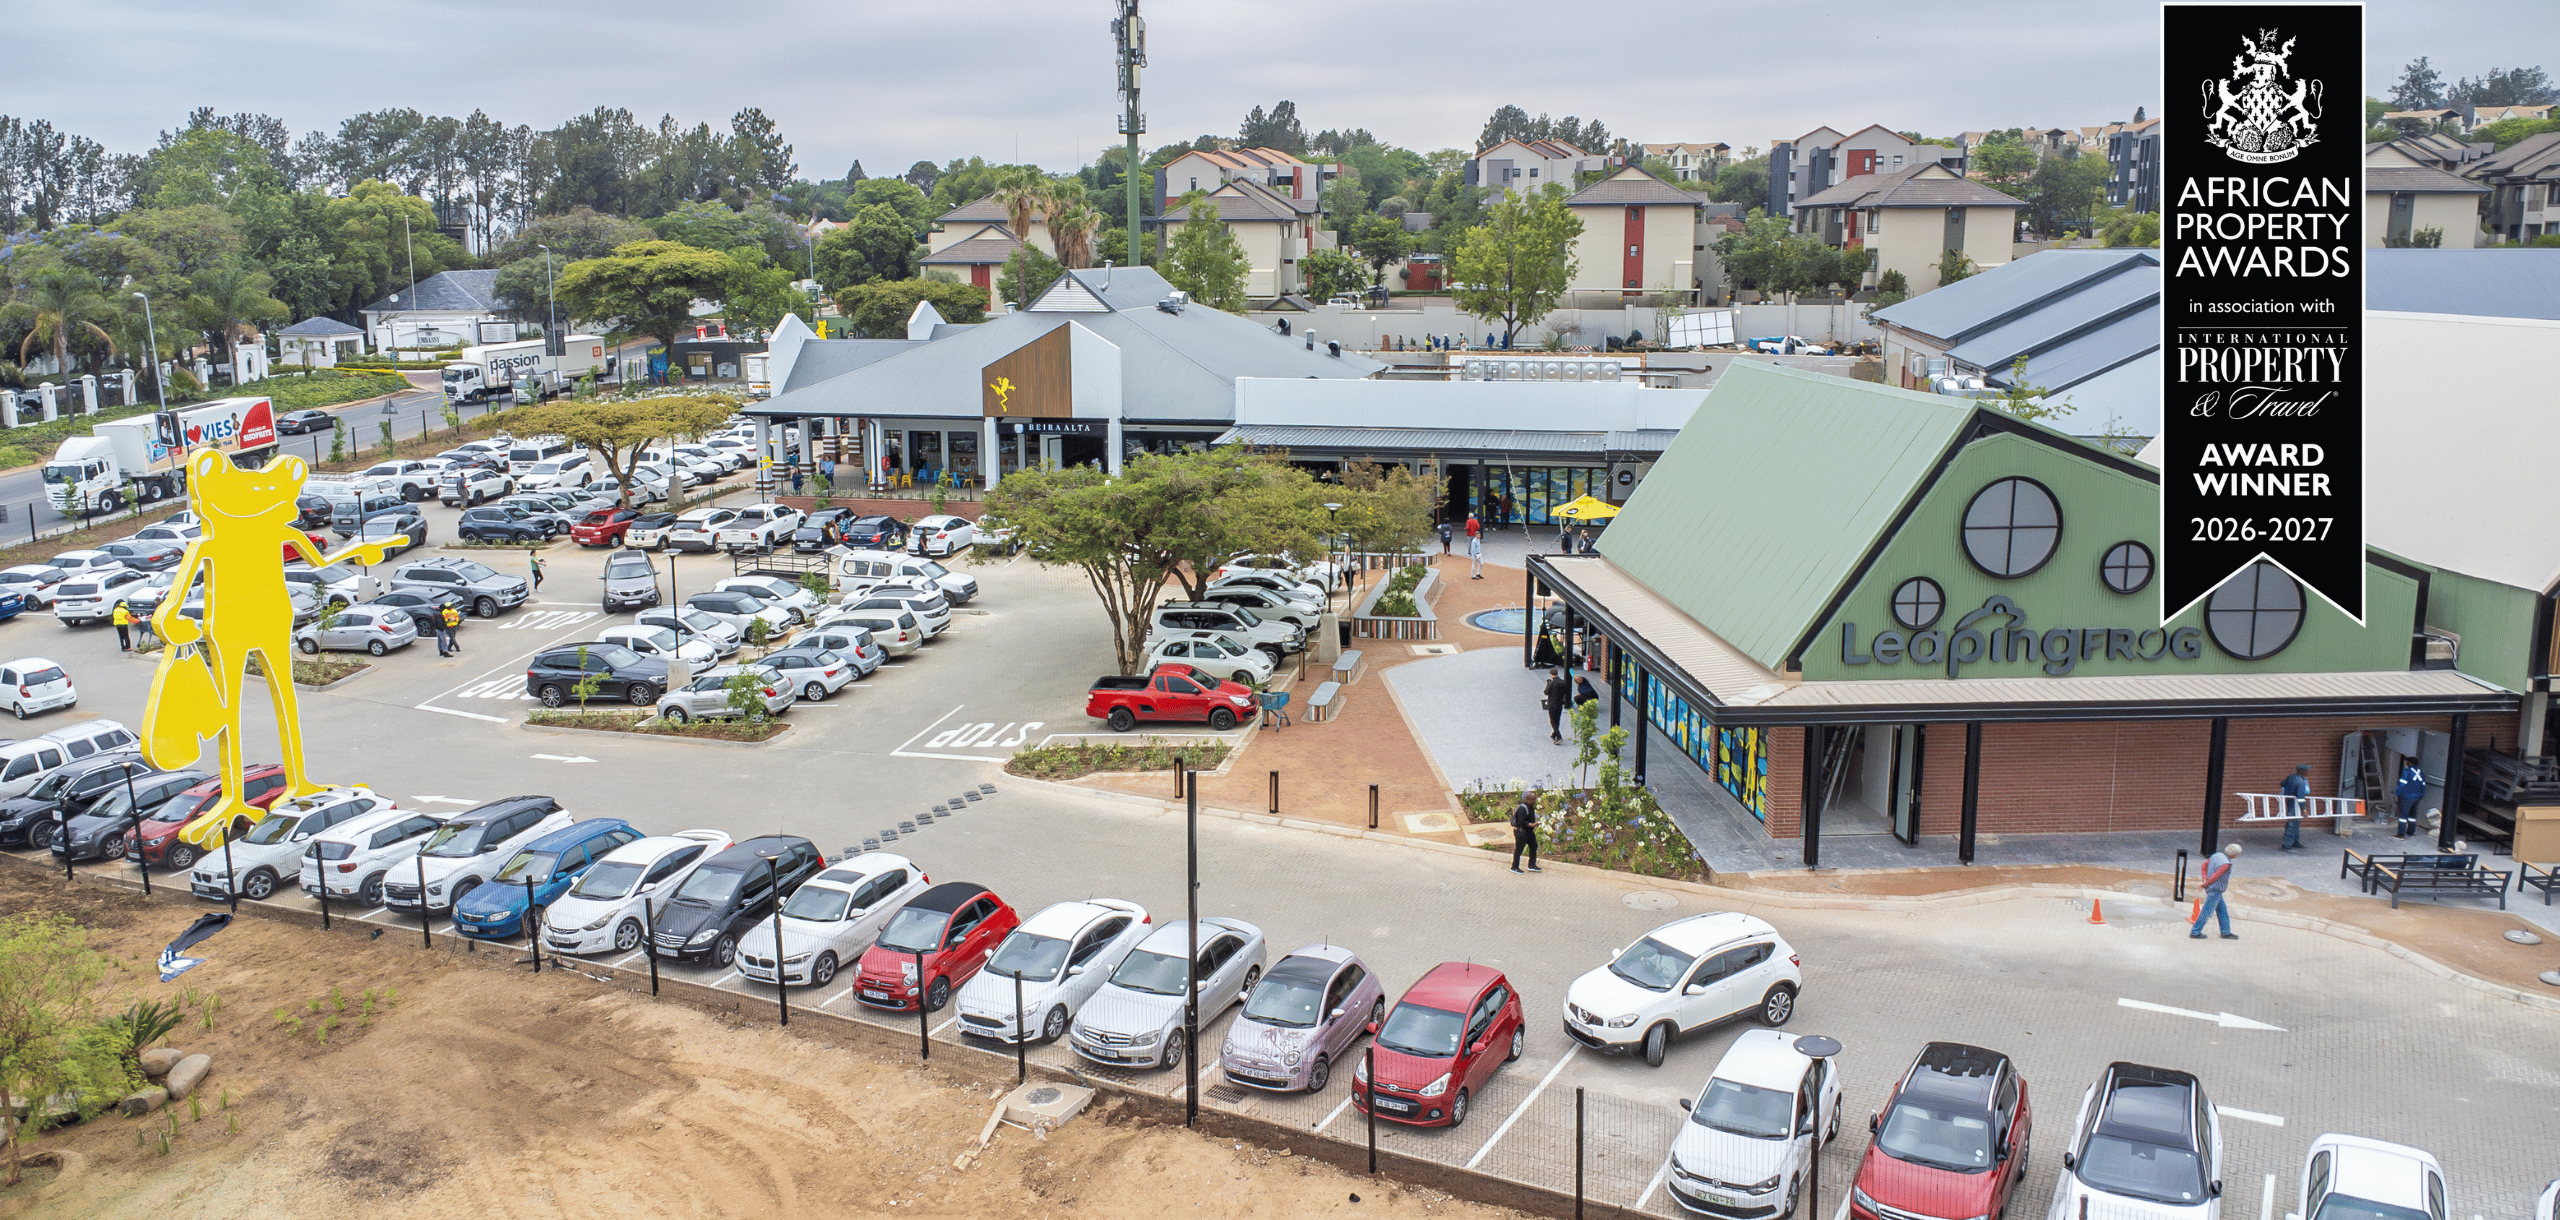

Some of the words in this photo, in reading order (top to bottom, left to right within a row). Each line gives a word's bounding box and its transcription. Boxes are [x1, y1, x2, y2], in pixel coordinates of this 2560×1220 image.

[489, 353, 541, 375] passion
[1028, 423, 1061, 431] BEIRA
[1063, 424, 1091, 432] ALTA
[497, 610, 598, 630] STOP
[923, 721, 1045, 748] STOP
